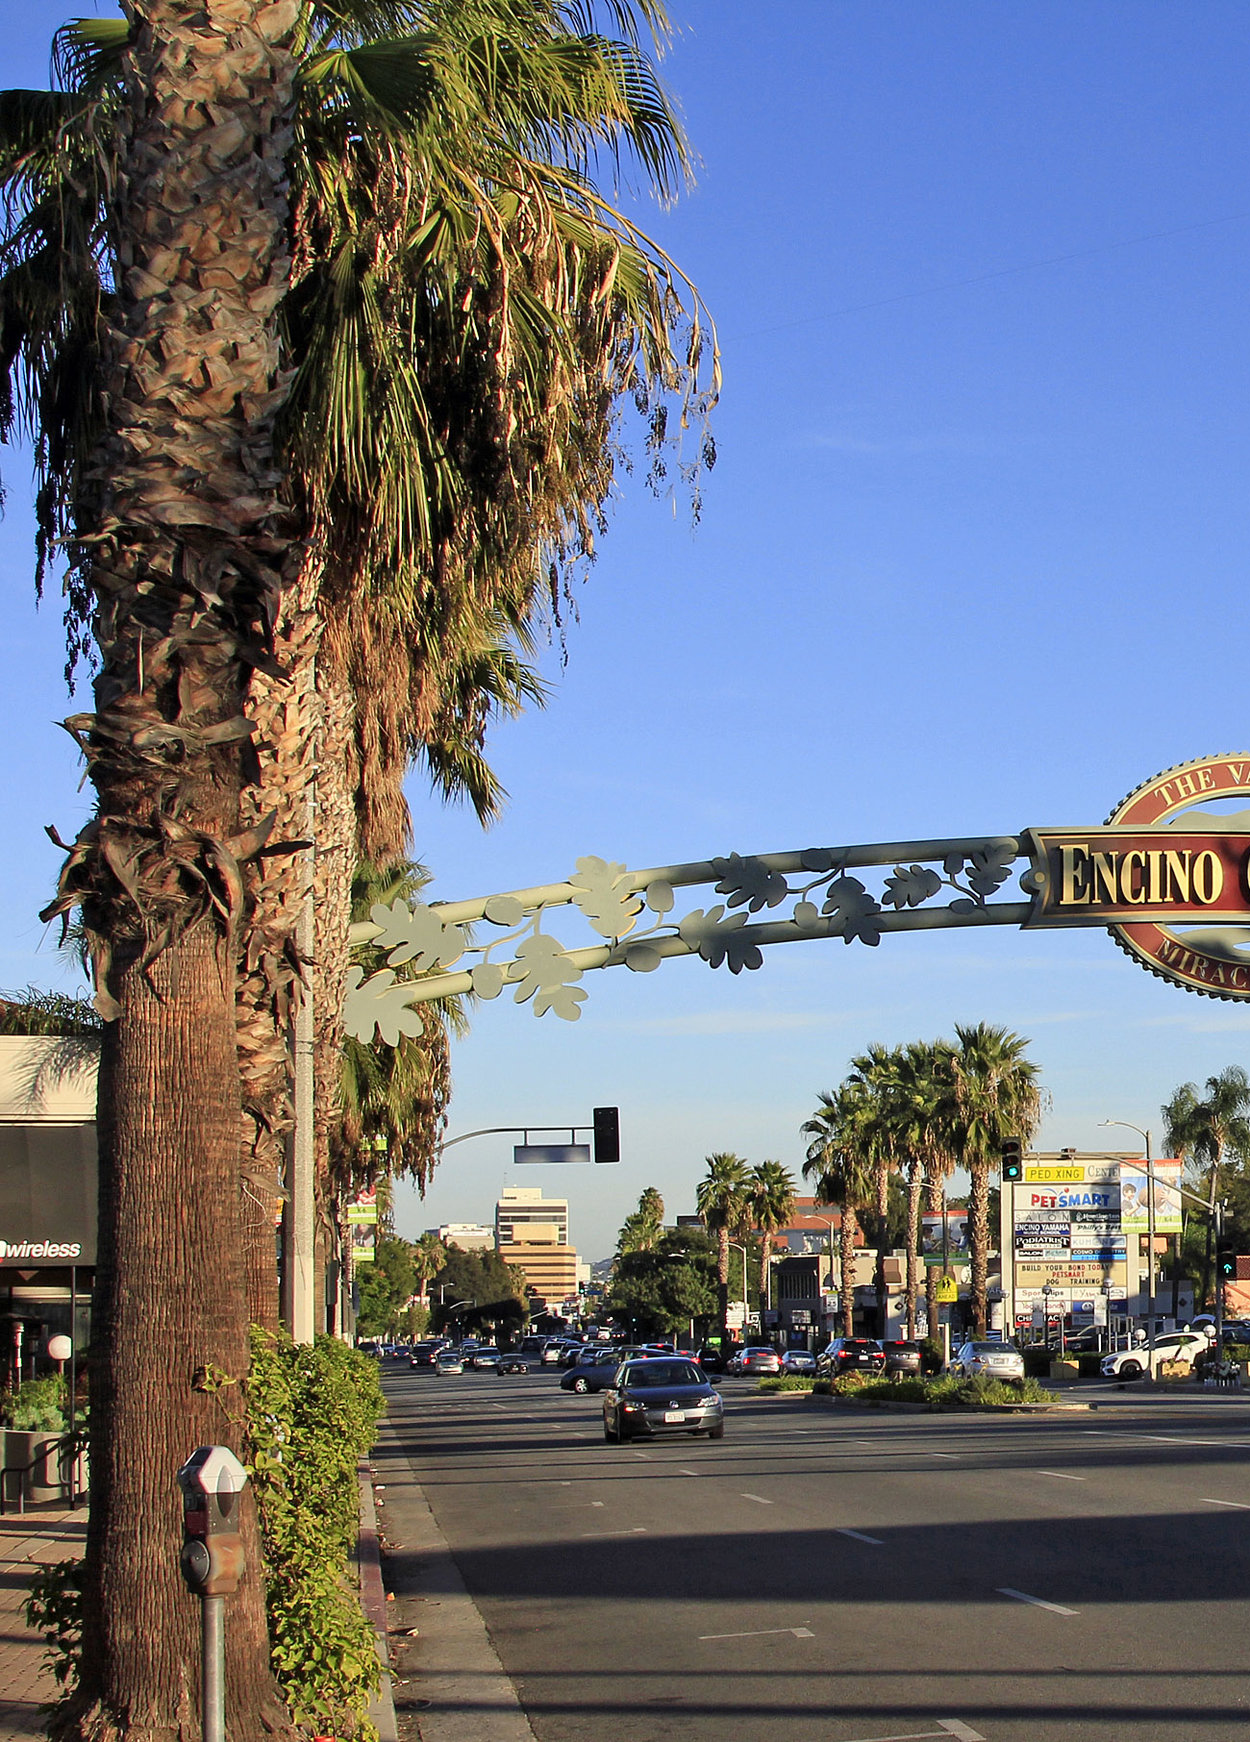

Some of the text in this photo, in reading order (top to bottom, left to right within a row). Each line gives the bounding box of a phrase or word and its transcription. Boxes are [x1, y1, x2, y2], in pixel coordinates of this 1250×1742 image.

[1154, 767, 1217, 808] THE
[1058, 841, 1226, 907] ENCINO
[1030, 1169, 1080, 1179] PED XING
[1087, 1165, 1120, 1178] CENTE
[1031, 1192, 1111, 1208] PETSMART
[1015, 1212, 1070, 1222] SALON
[1015, 1223, 1070, 1231] ENCINO YAMAHA
[1022, 1289, 1043, 1297] Spor
